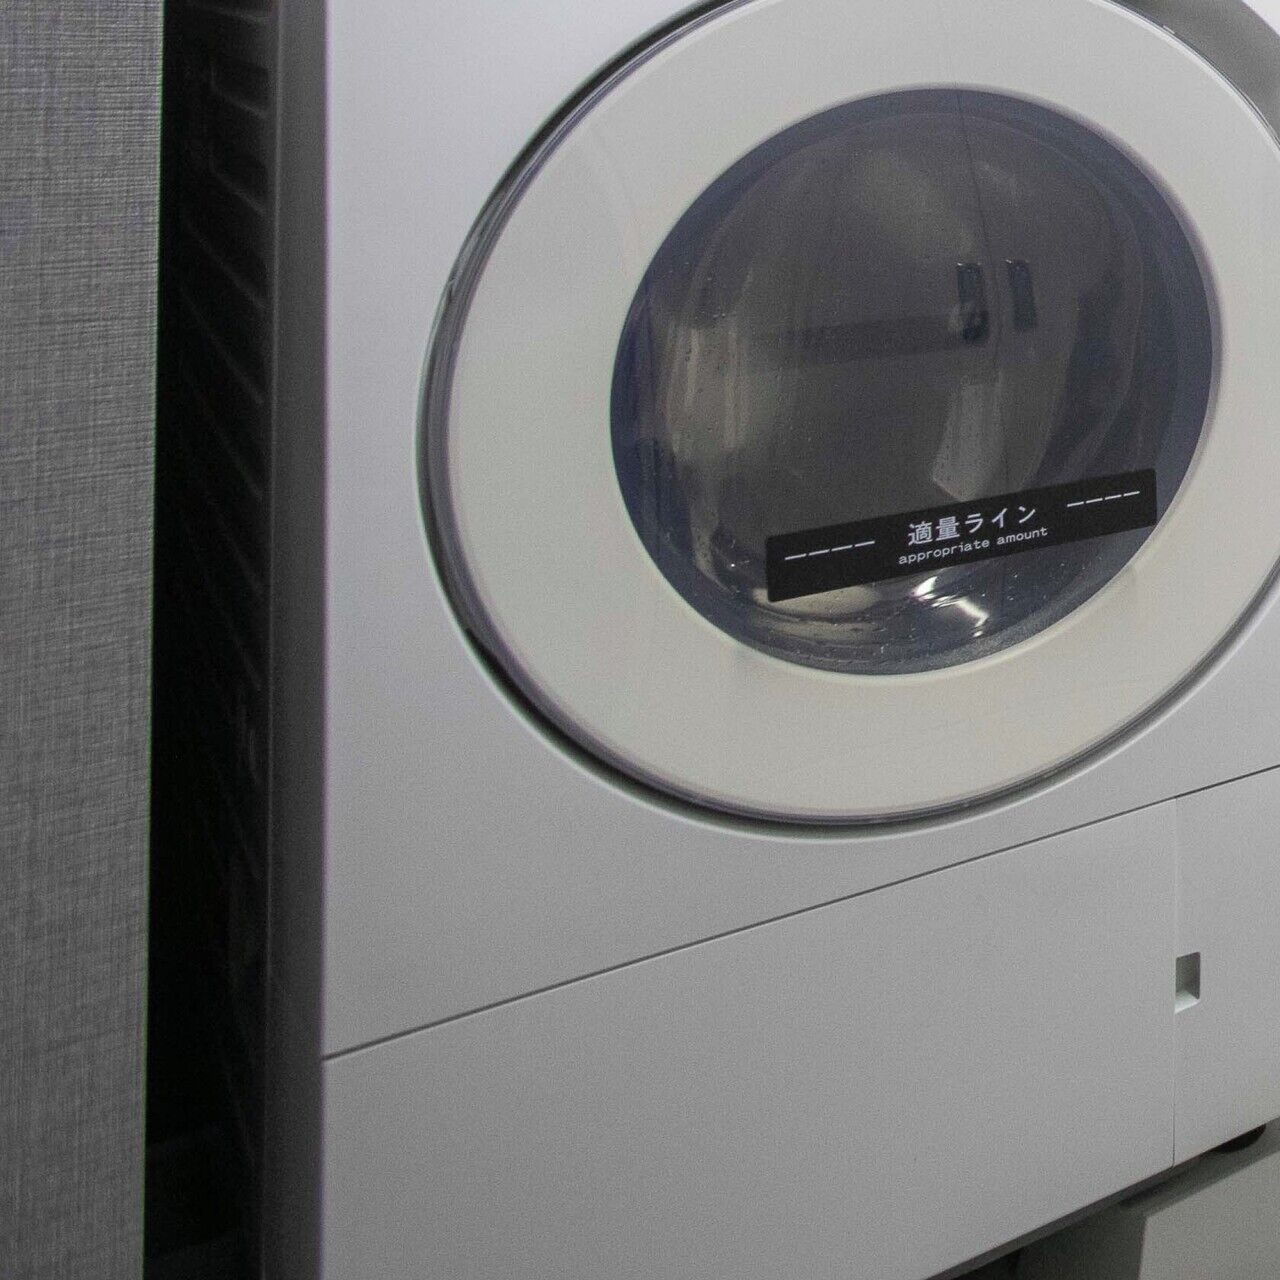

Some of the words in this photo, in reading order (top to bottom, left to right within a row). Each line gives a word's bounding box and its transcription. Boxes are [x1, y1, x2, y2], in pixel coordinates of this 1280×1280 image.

[907, 504, 1037, 546] 適量ライン
[898, 537, 990, 566] appropriate
[996, 526, 1049, 547] amount
